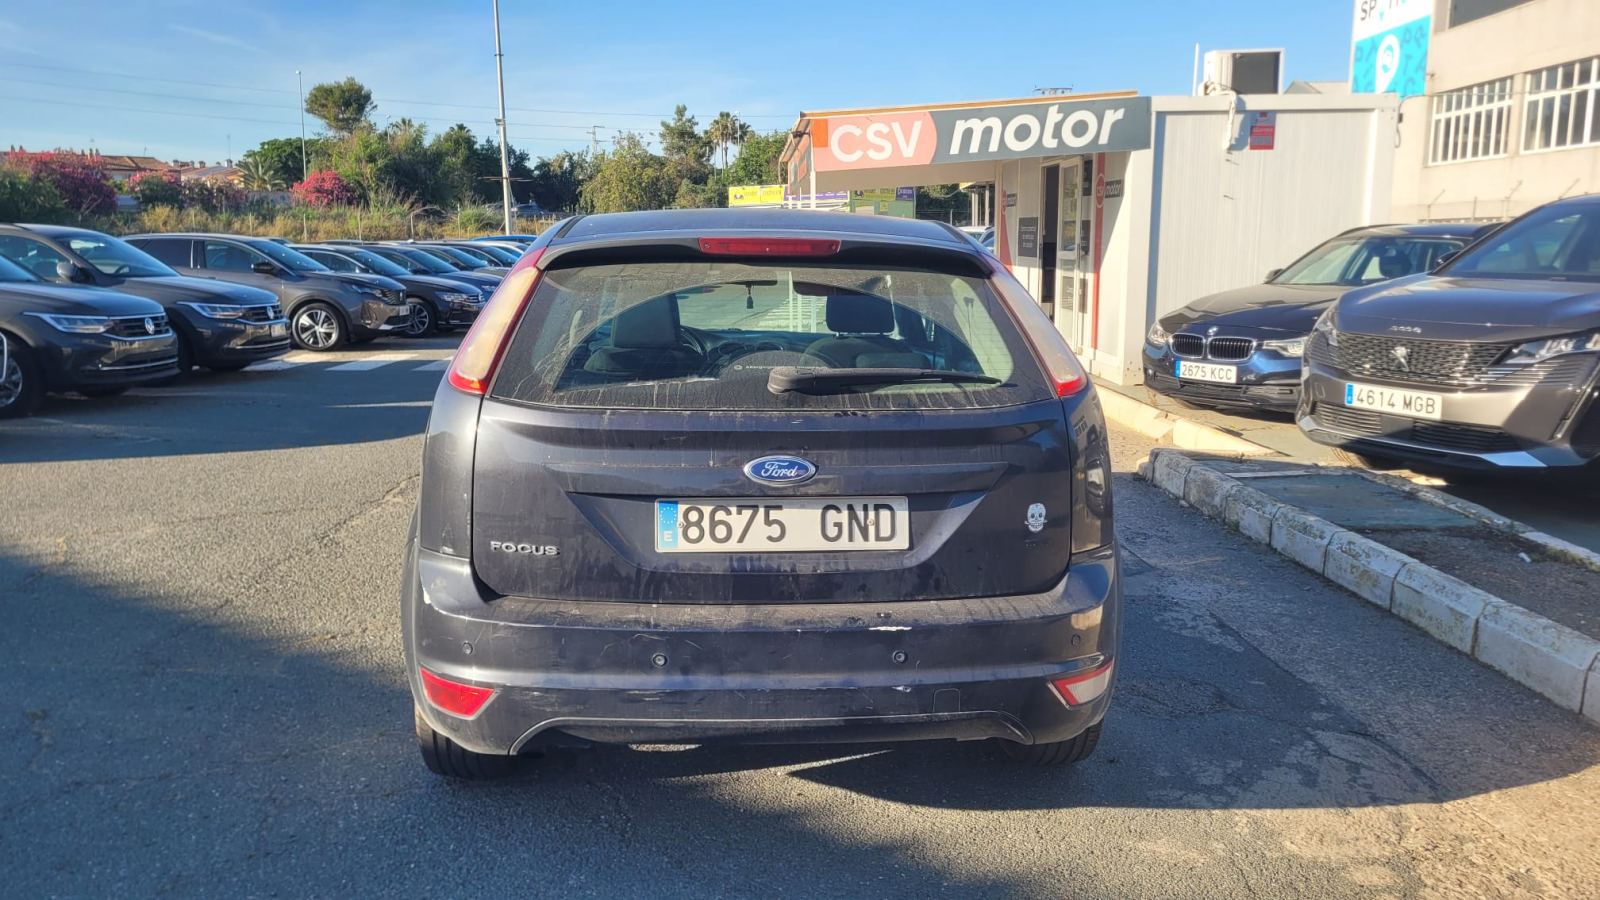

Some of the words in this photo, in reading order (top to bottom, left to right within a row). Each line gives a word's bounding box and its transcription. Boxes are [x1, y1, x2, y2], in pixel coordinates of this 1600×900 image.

[830, 120, 922, 163] CSV
[949, 104, 1125, 155] motor
[1105, 183, 1121, 195] motor
[1182, 364, 1207, 378] 2675
[1210, 367, 1233, 381] KCC
[1356, 388, 1396, 408] 4614
[1402, 394, 1436, 414] MGB
[761, 461, 799, 477] Ford
[681, 504, 787, 545] 8675
[820, 503, 897, 543] GND
[663, 530, 673, 542] E
[490, 541, 558, 556] FOCUS
